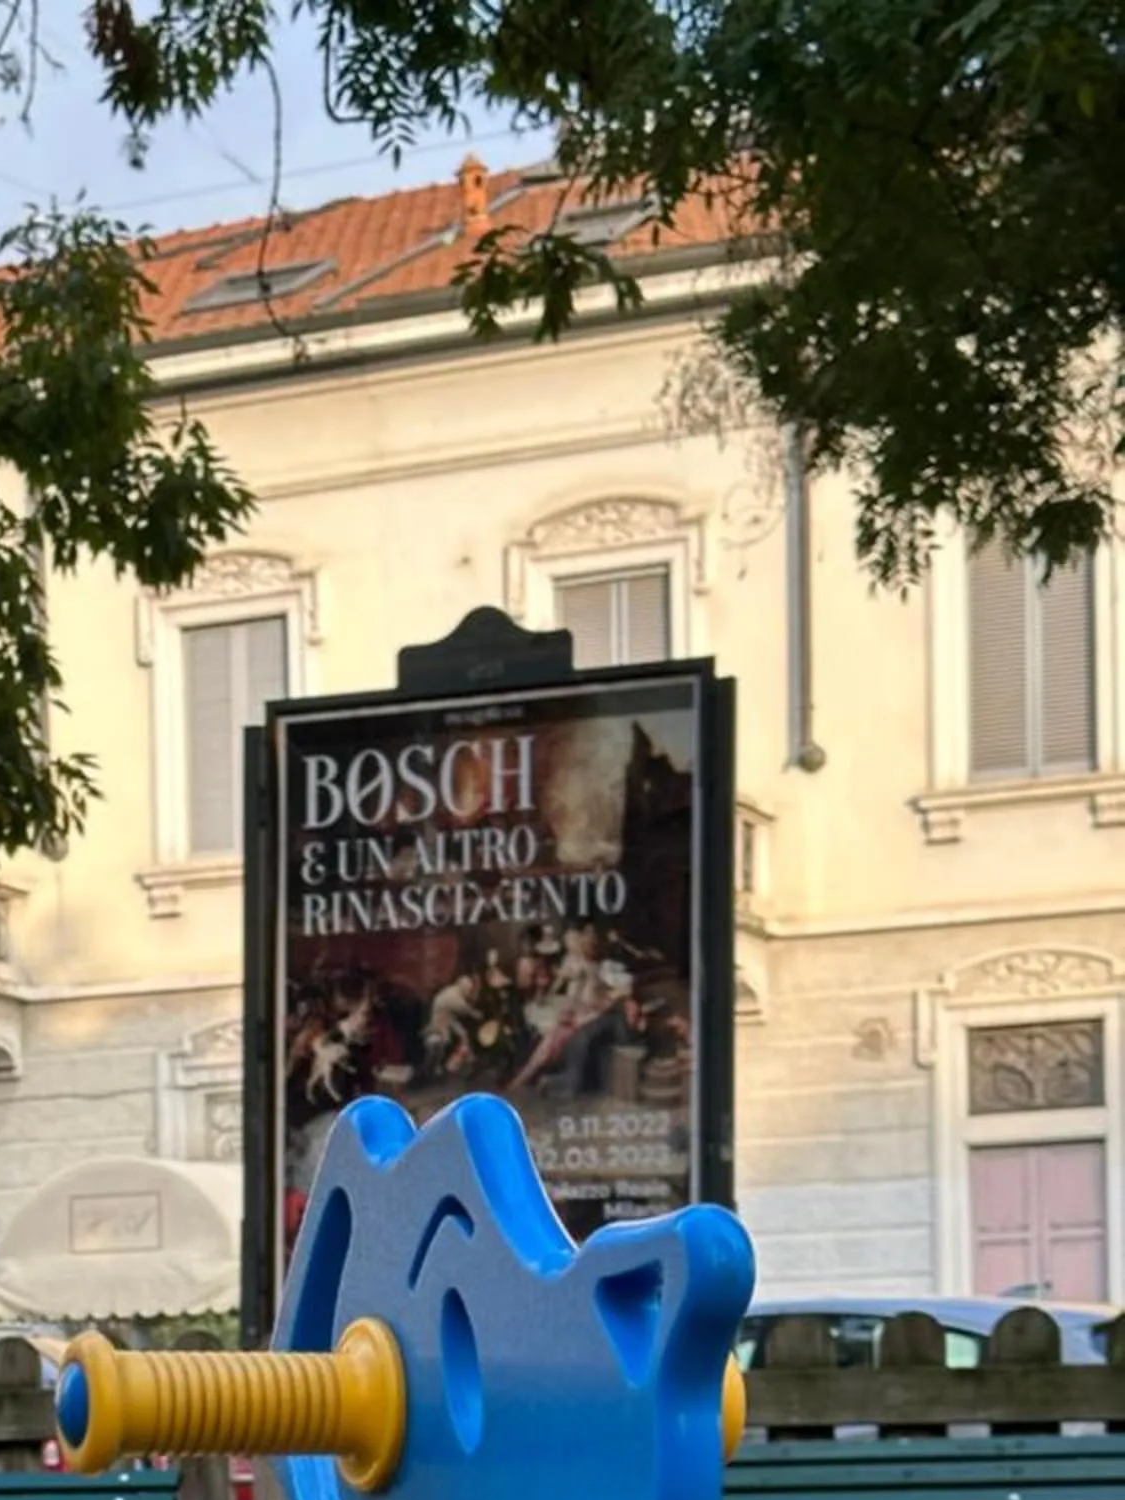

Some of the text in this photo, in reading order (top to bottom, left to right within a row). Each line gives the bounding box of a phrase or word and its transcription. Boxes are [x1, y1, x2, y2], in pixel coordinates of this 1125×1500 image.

[336, 835, 395, 882] UN
[413, 824, 538, 876] ALTRO
[558, 1111, 671, 1139] 9.11.2022
